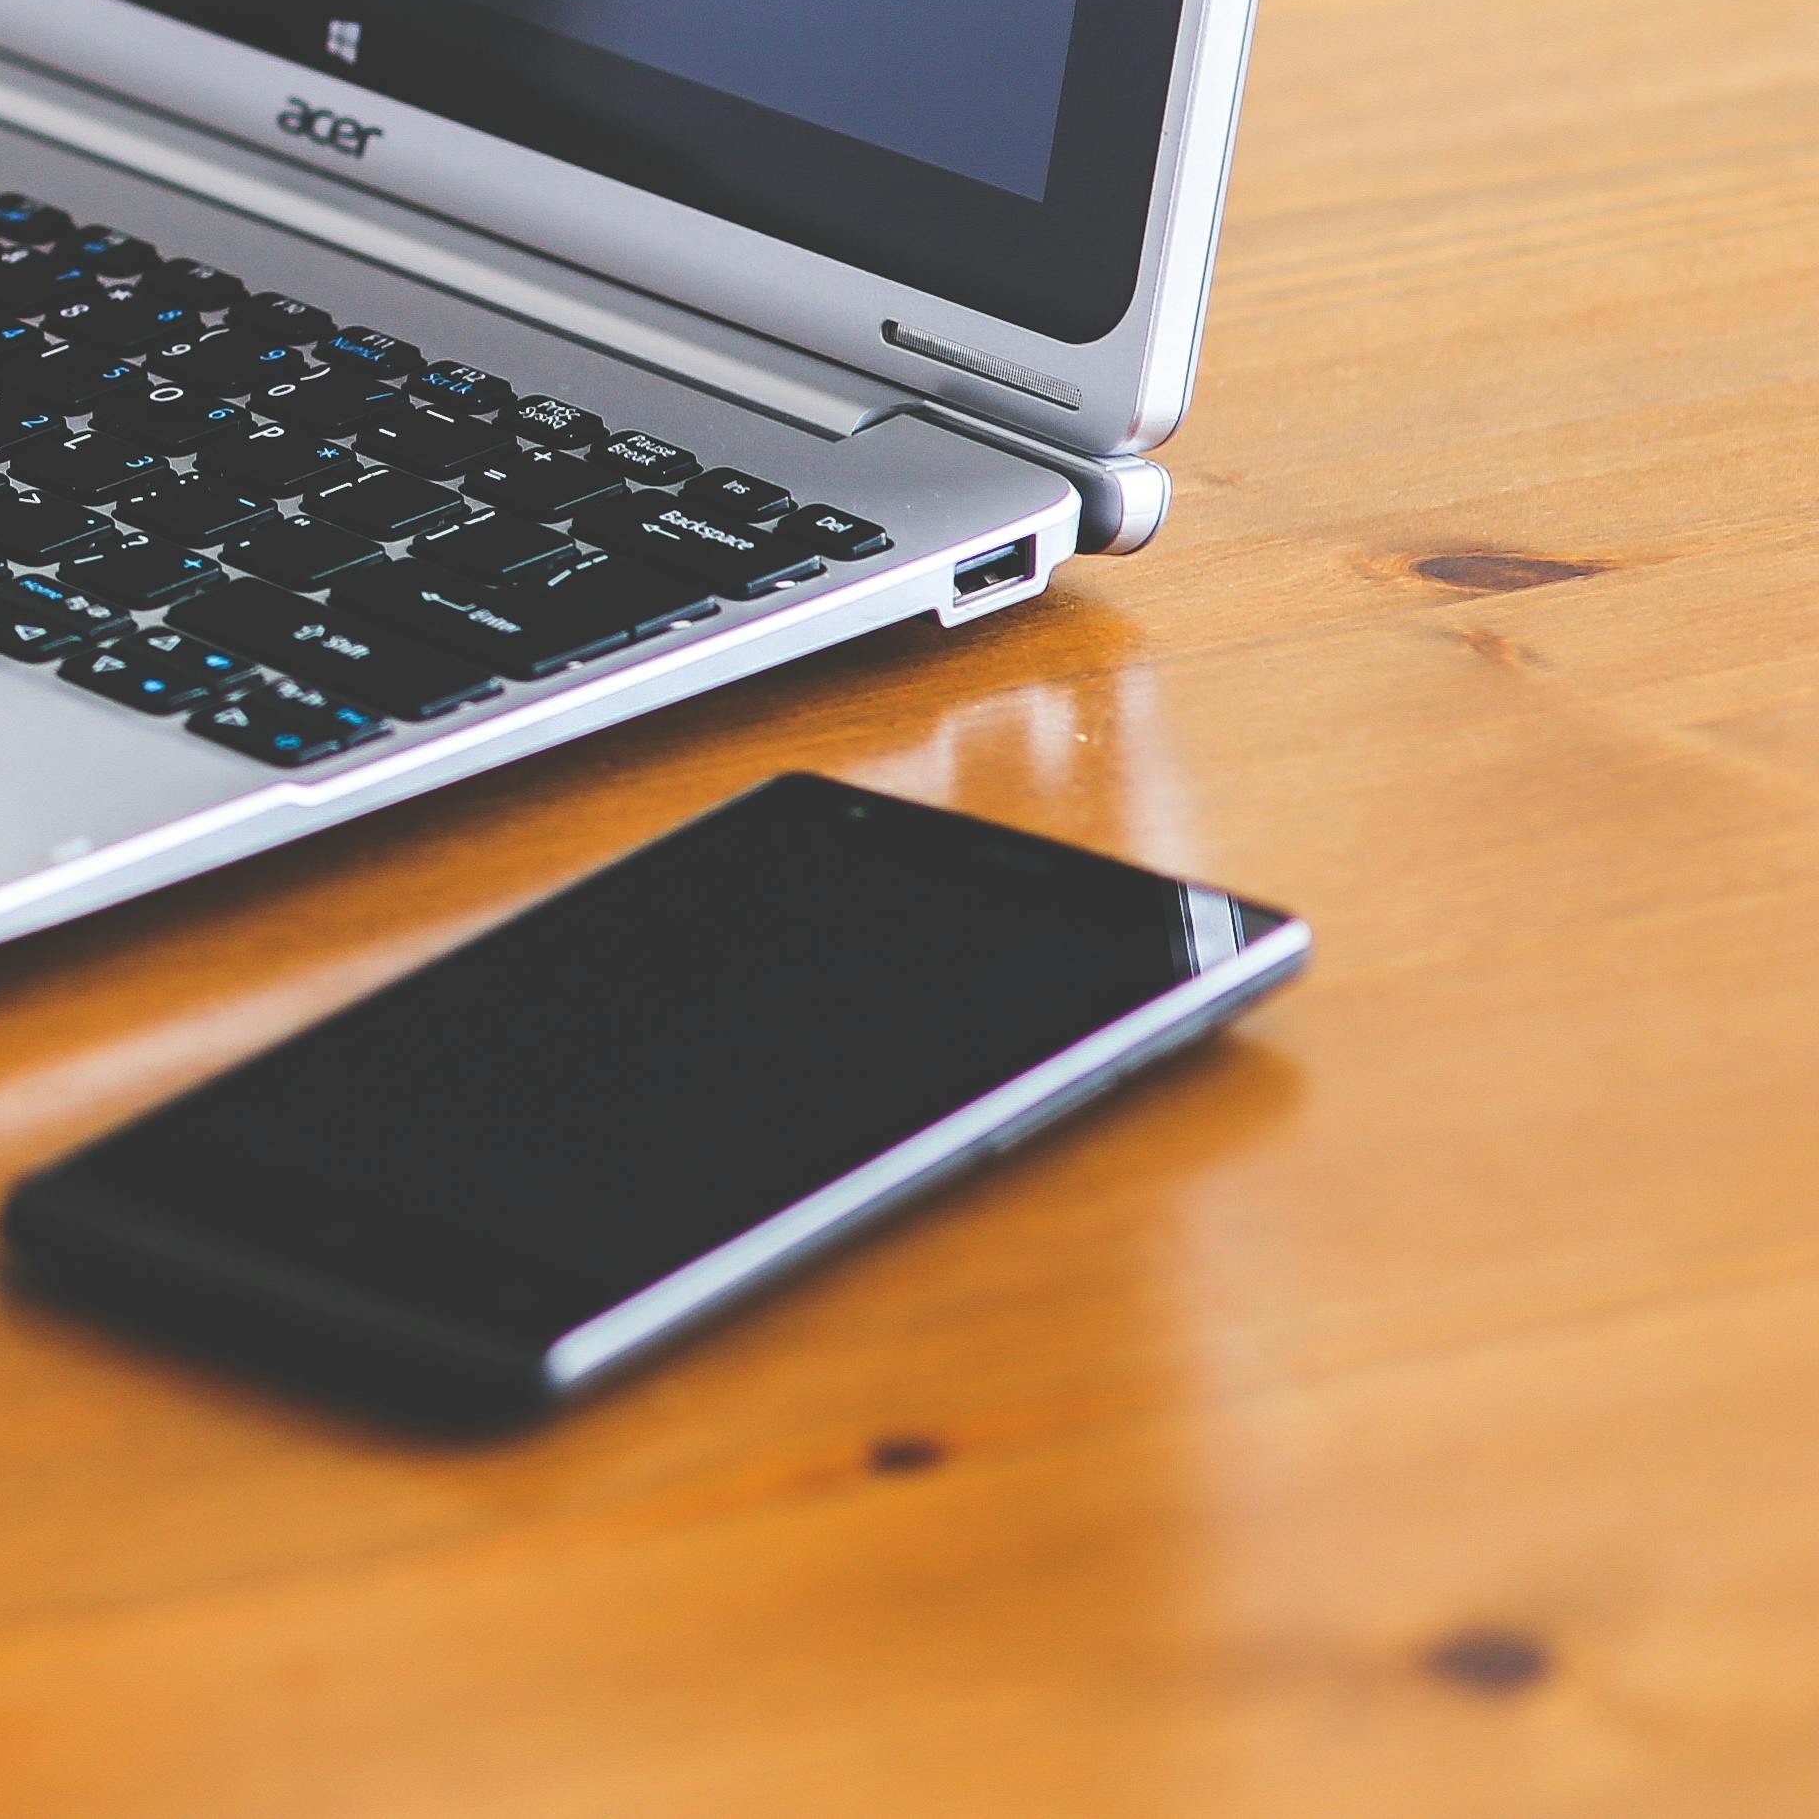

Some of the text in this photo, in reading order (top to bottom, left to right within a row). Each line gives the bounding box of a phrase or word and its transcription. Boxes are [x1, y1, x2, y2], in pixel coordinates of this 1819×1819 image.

[277, 95, 384, 159] acer
[60, 305, 89, 317] 8
[362, 335, 395, 349] F11
[162, 344, 191, 356] 9
[260, 350, 286, 360] 9
[103, 367, 129, 378] 5
[150, 387, 183, 401] O
[268, 385, 295, 396] 0
[209, 409, 234, 419] 6
[21, 416, 48, 428] 2
[249, 424, 284, 439] P
[64, 432, 91, 449] L
[627, 435, 677, 457] Pause
[608, 442, 659, 466] Break
[126, 456, 153, 467] 3
[723, 480, 750, 494] Ins
[659, 510, 754, 550] Backspace
[816, 516, 854, 533] Del
[122, 532, 148, 548] ?
